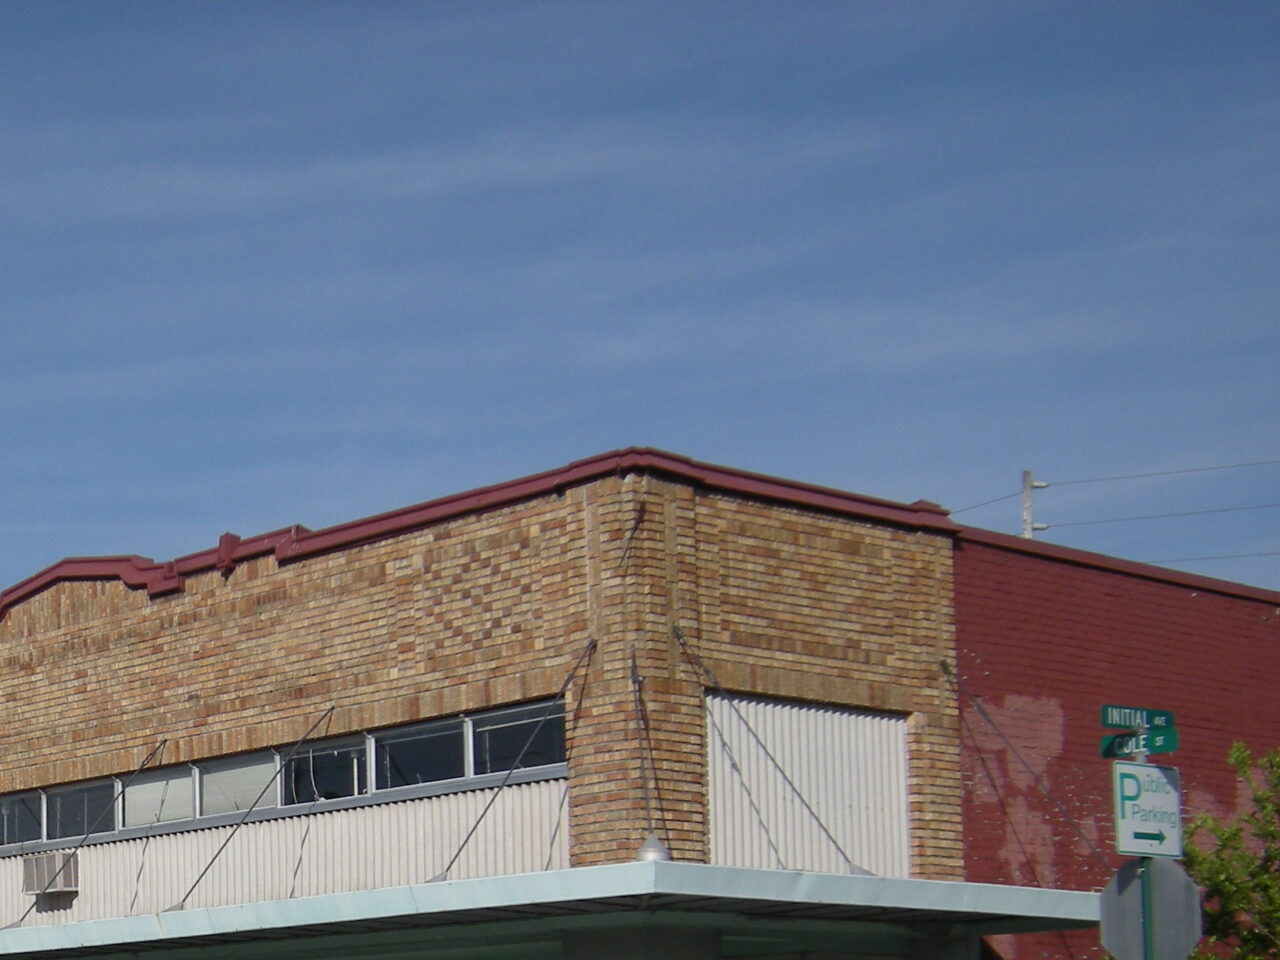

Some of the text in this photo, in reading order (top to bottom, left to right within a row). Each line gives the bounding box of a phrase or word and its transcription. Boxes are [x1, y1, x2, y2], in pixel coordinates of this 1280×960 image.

[1108, 706, 1166, 728] INITIAL AVE
[1115, 735, 1165, 754] COLE ST
[1131, 803, 1177, 829] Parking
